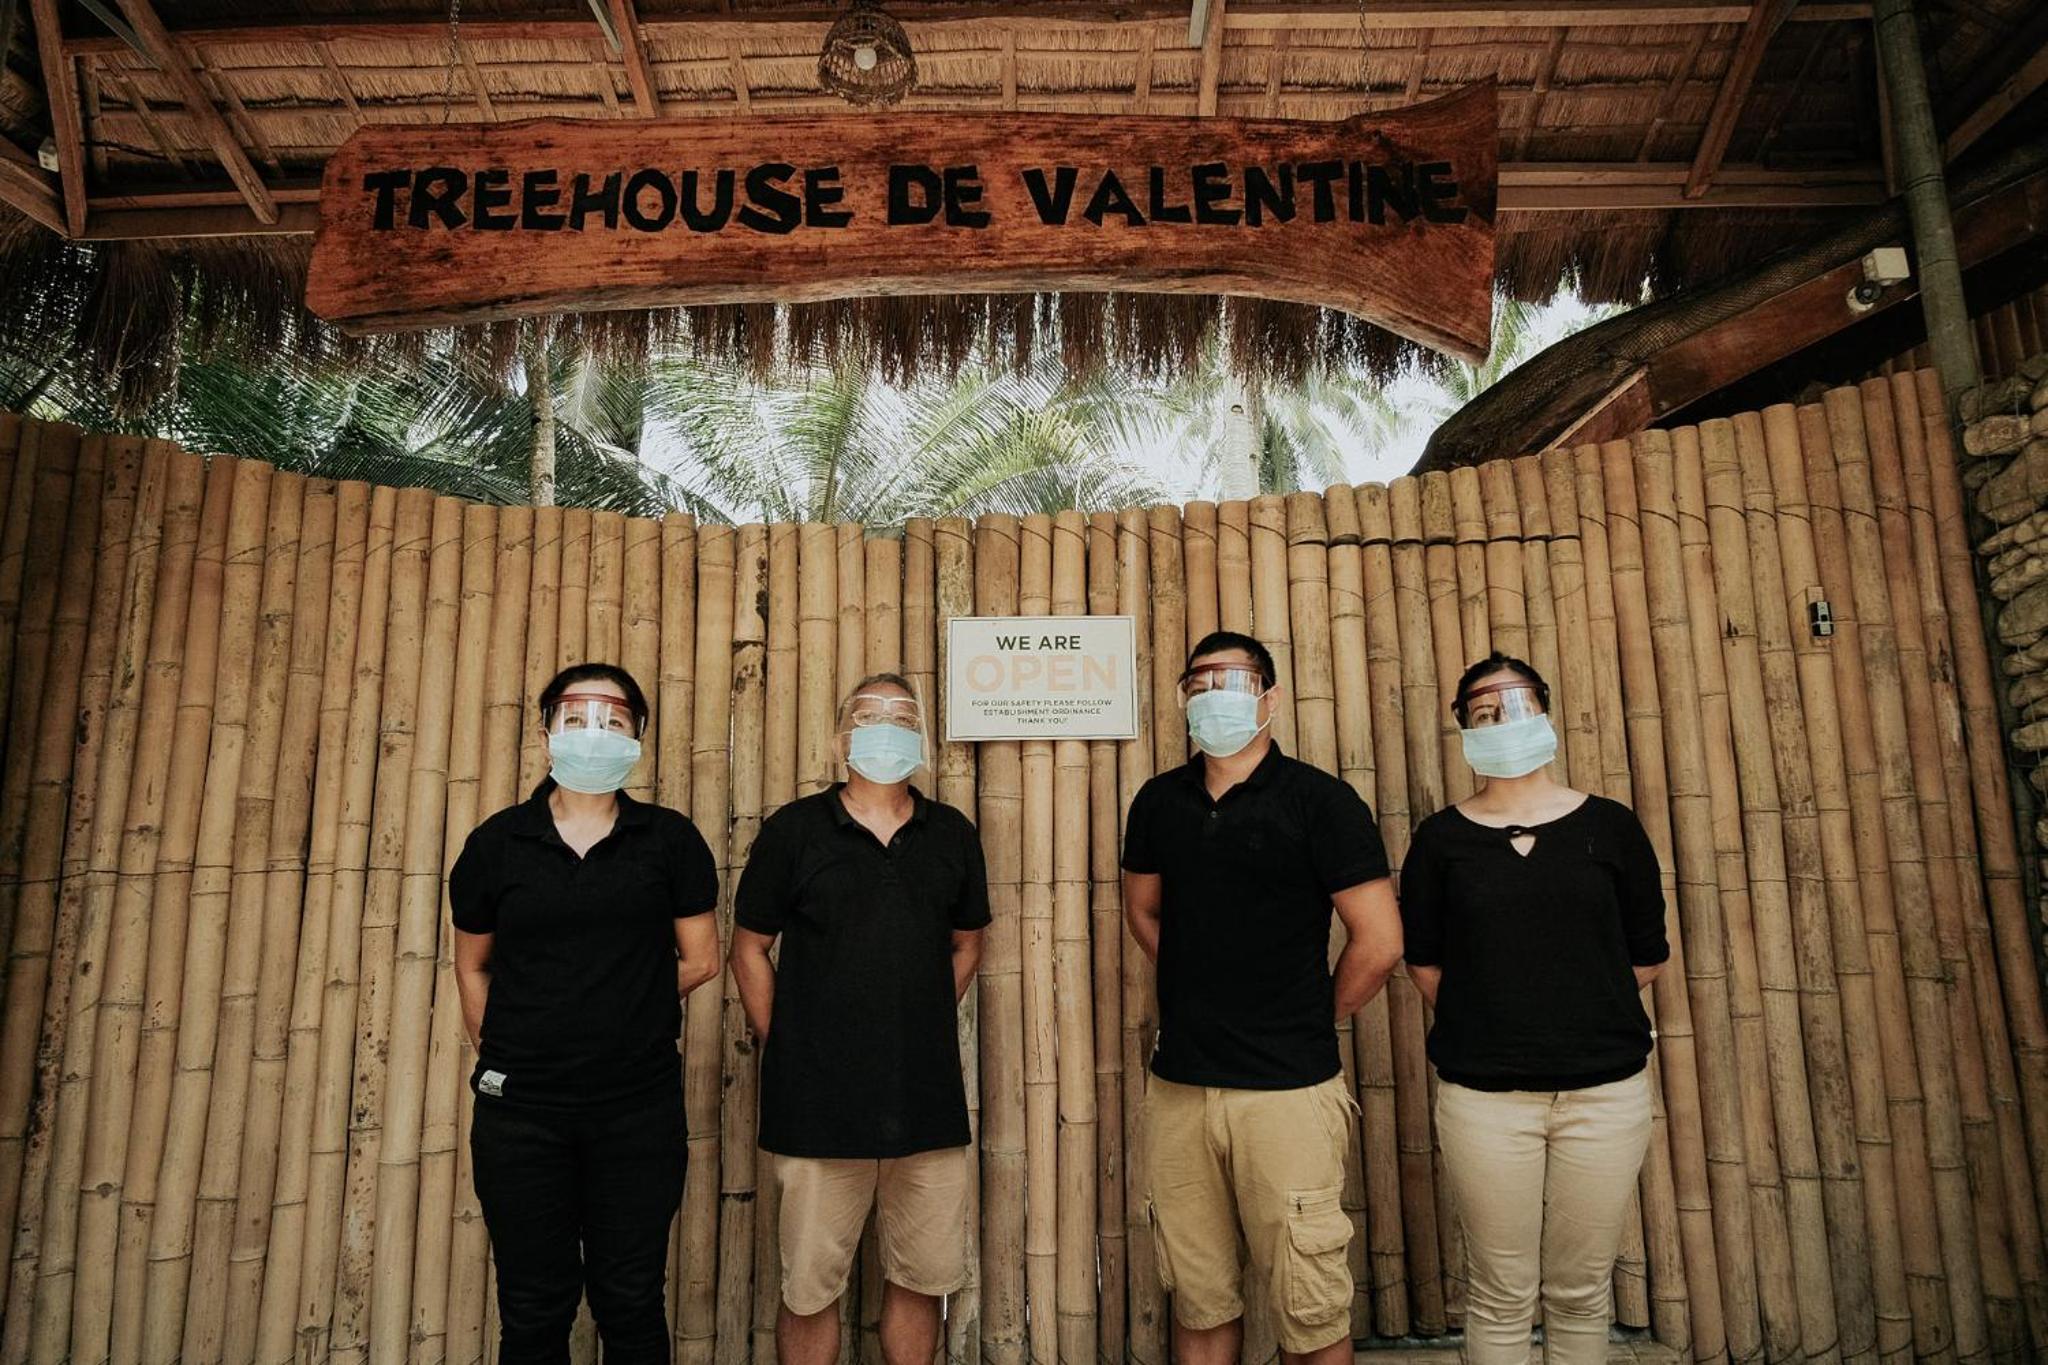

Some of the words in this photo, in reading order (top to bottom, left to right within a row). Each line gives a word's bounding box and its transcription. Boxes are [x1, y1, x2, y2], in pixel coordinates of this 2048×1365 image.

[362, 162, 855, 235] TREEHOUSE
[887, 163, 992, 229] DE
[1021, 159, 1469, 228] VALENTINE
[996, 635, 1031, 650] WE
[1038, 635, 1082, 650] ARE
[966, 654, 1118, 693] OPEN
[971, 699, 989, 707] FOR
[991, 699, 1008, 707] OUR
[983, 708, 1050, 716] ESTABLISHMENT
[1052, 707, 1101, 715] ORDINANCE
[1017, 717, 1044, 725] THANK
